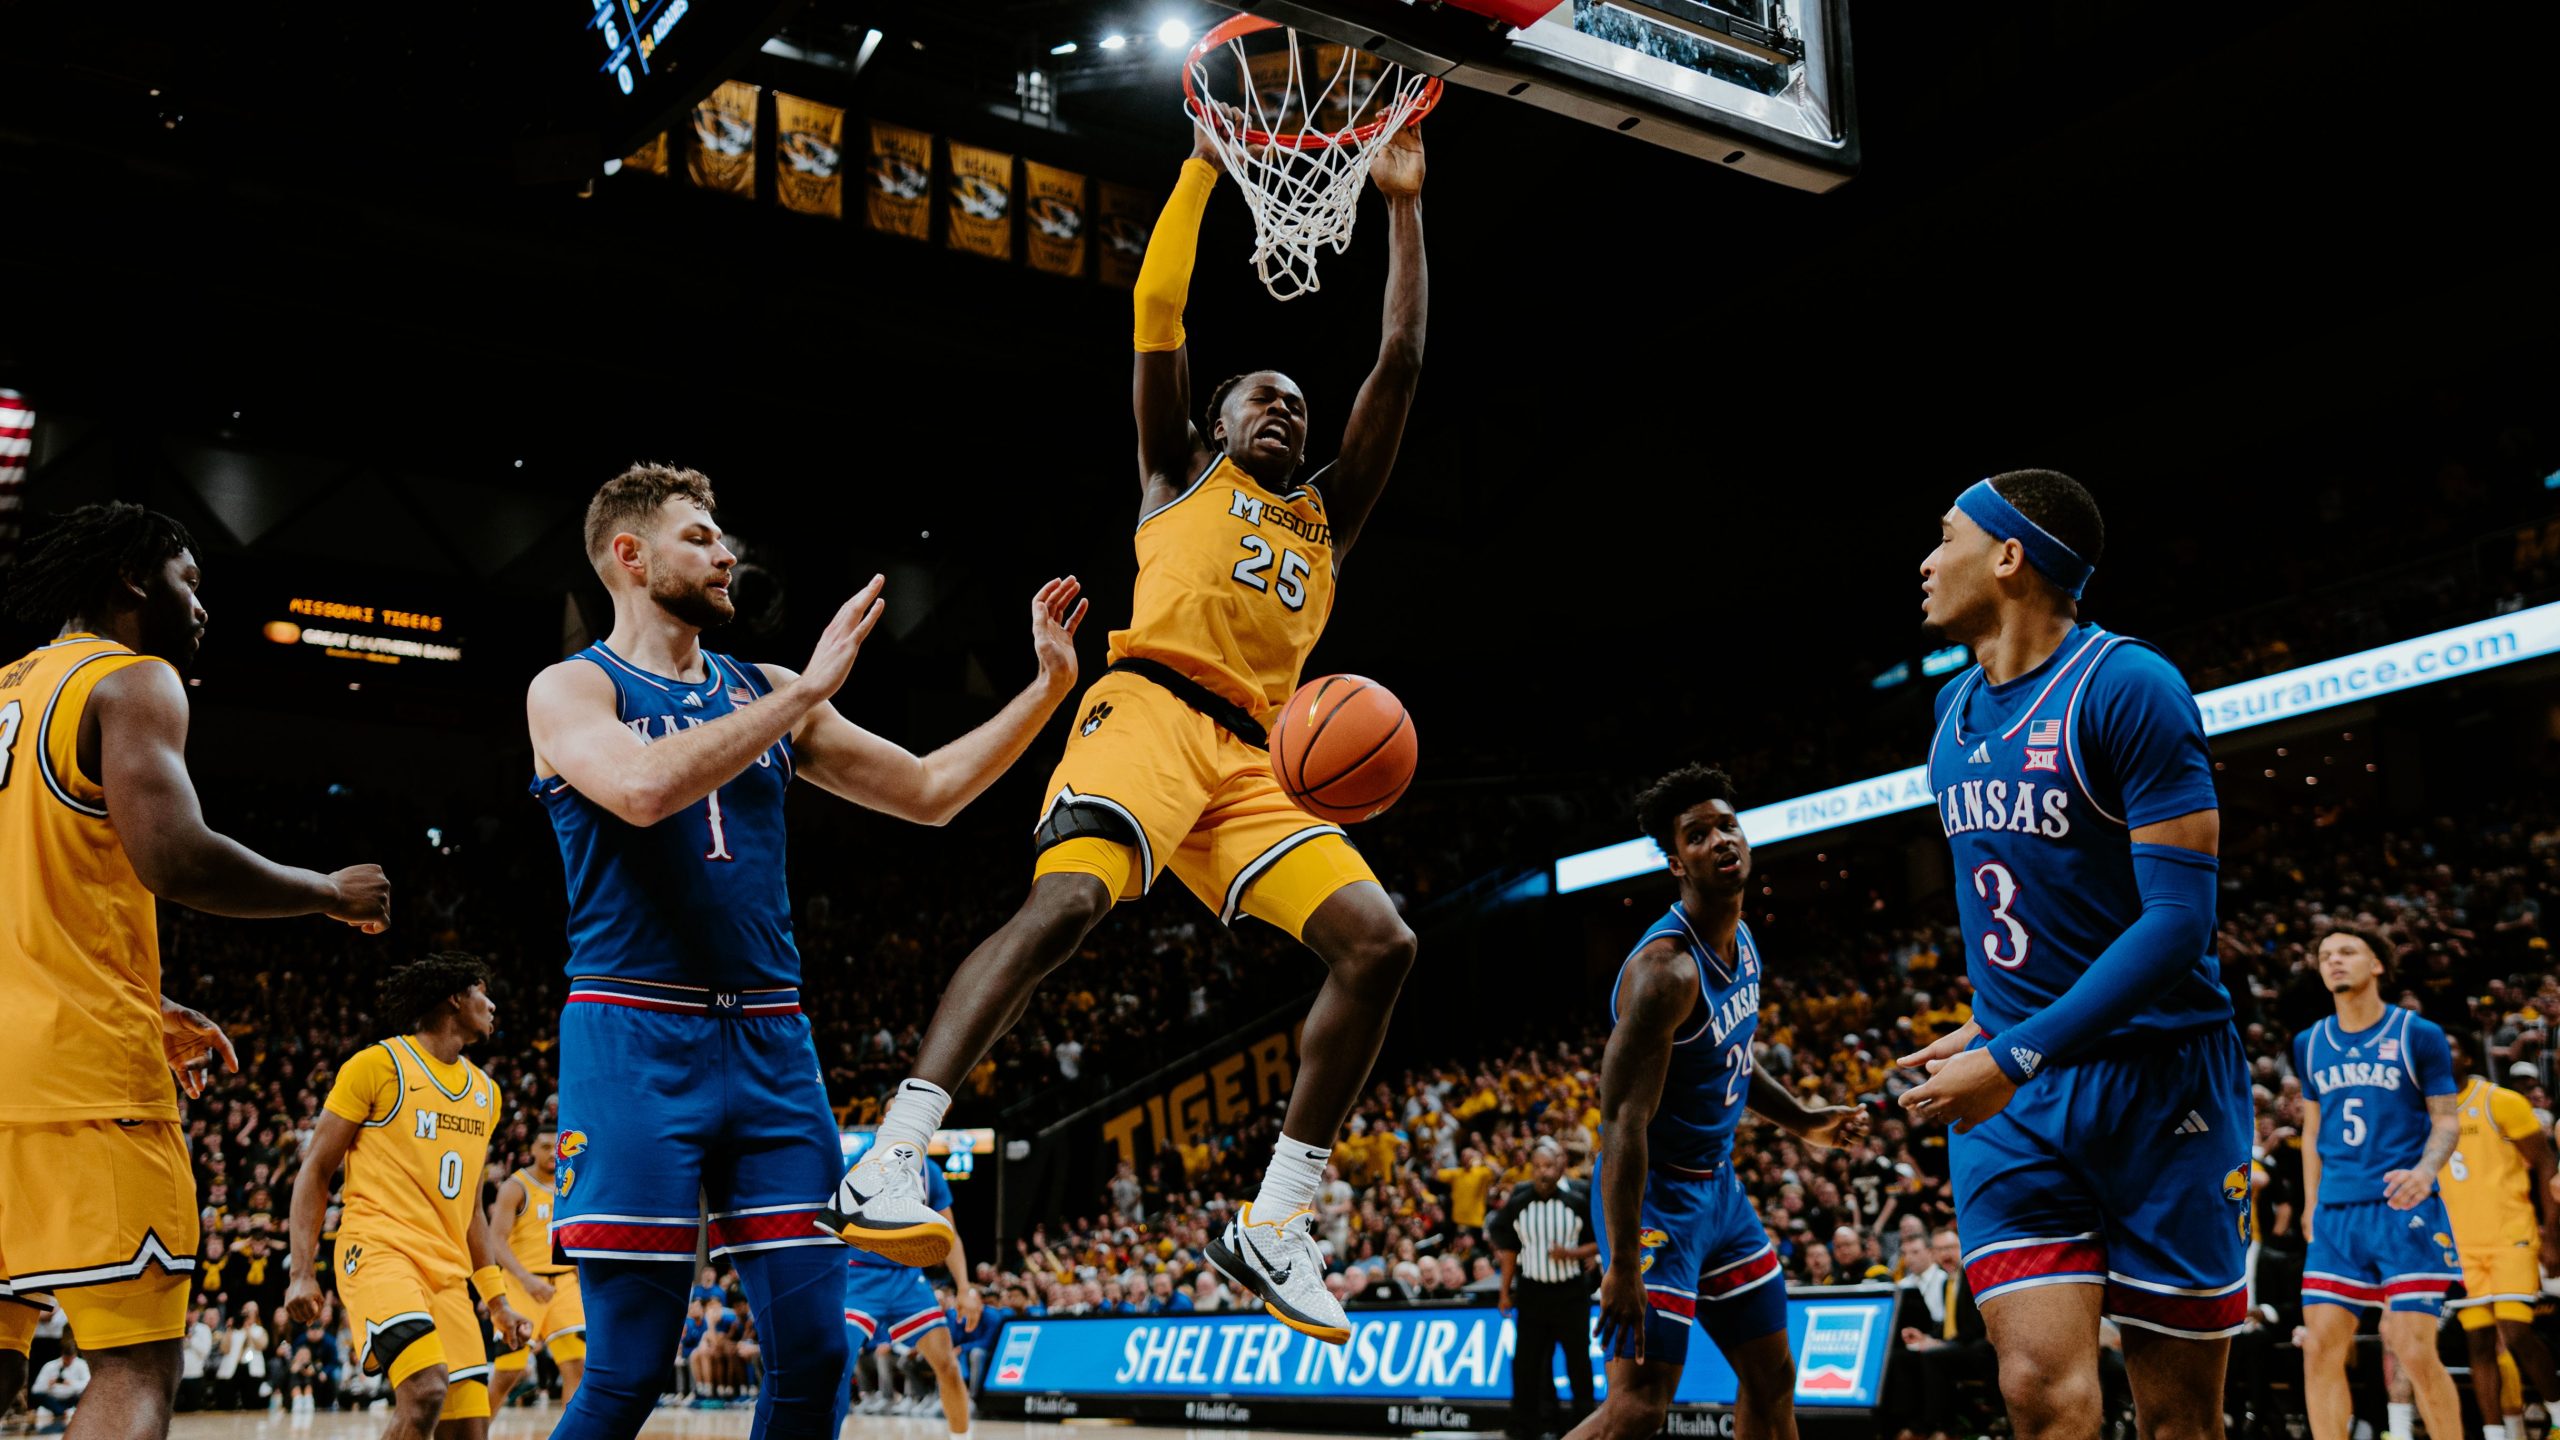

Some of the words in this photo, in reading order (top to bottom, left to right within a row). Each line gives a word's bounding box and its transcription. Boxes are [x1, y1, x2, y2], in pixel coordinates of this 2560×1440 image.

[604, 20, 620, 50] 6
[618, 64, 634, 95] 0
[1229, 489, 1332, 548] MISSOUR
[1232, 534, 1311, 612] 25
[289, 598, 374, 624] MISSOURI
[382, 610, 442, 632] TIGERS
[704, 788, 735, 862] 1
[1785, 794, 1848, 829] FIND
[1855, 781, 1896, 812] AN
[1972, 860, 2033, 971] 3
[715, 992, 737, 1008] KU
[2010, 1046, 2035, 1080] adidas
[2312, 1061, 2402, 1095] KANSAS
[1103, 1018, 1303, 1168] TIGER
[414, 1108, 485, 1141] MISSOURI
[2342, 1097, 2368, 1147] 5
[438, 1150, 464, 1200] 0
[1114, 1323, 1293, 1385] SHELTER
[1294, 1318, 1518, 1388] INSURAN
[1667, 1412, 1719, 1437] Health
